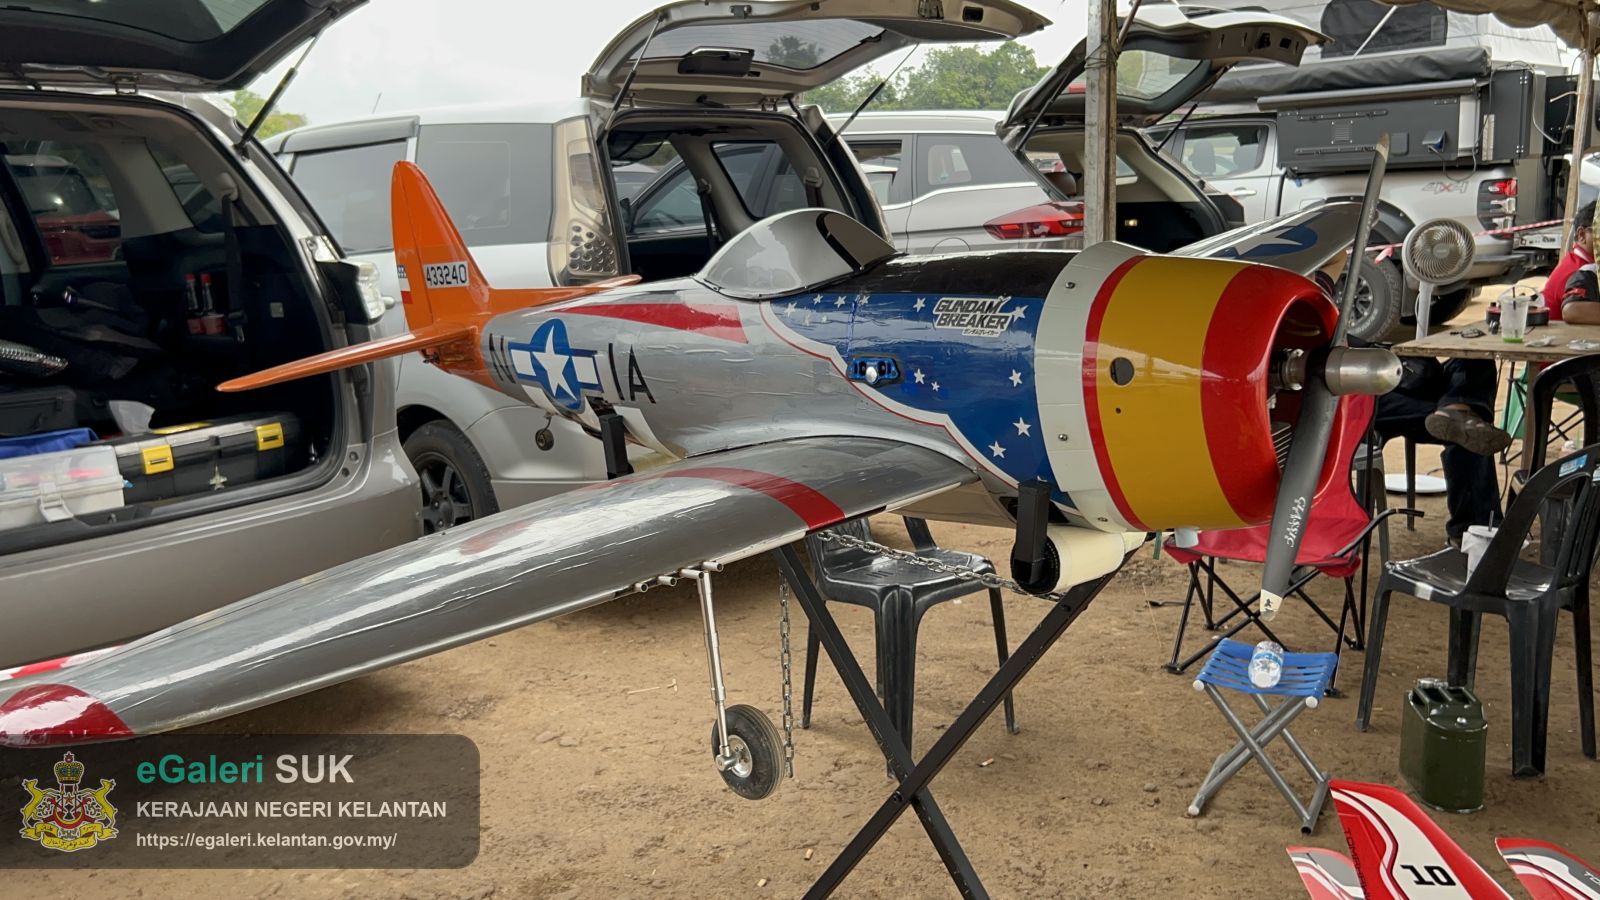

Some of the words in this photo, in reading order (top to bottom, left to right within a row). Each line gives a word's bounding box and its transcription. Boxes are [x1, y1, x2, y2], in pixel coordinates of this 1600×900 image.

[426, 264, 467, 286] 433240
[934, 299, 1002, 314] GUNDAM
[936, 313, 1010, 329] BREAKER
[489, 333, 516, 384] N
[1400, 865, 1456, 886] 10
